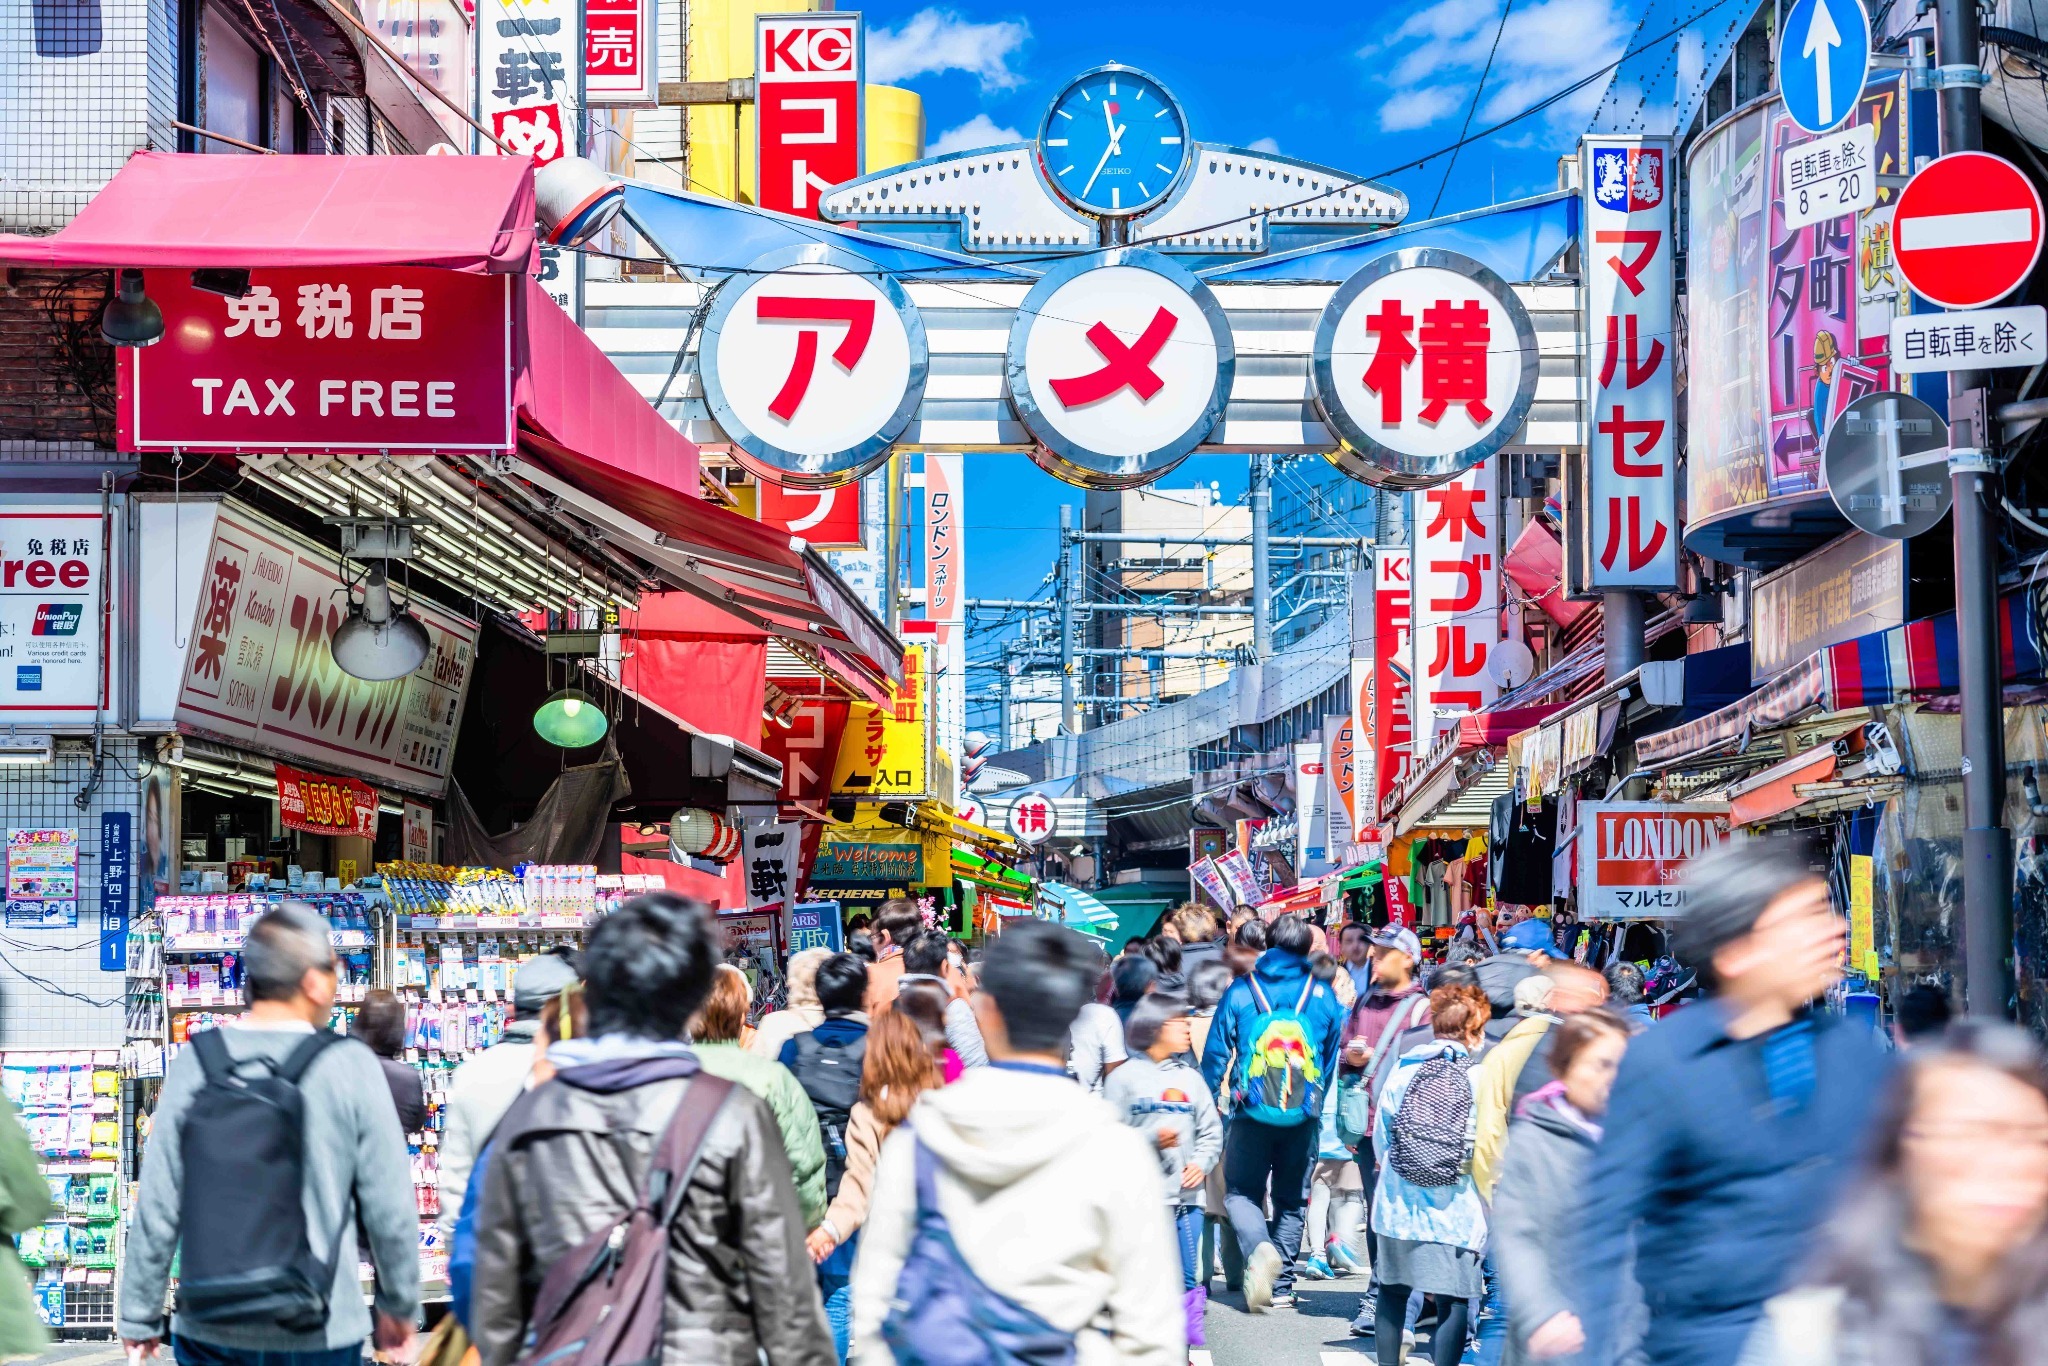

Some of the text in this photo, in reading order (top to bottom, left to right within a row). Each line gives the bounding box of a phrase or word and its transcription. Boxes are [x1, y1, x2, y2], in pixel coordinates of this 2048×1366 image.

[586, 27, 634, 68] 売
[764, 27, 852, 72] KG
[1101, 167, 1131, 175] SEIKO
[1790, 140, 1866, 185] 自転車を除く
[1799, 190, 1809, 215] 8
[1839, 176, 1860, 203] 20
[225, 282, 425, 340] 免税店
[757, 295, 1492, 425] アメ横
[1904, 321, 2034, 360] 自転車を除く
[191, 378, 456, 417] TAX FREE
[1595, 230, 1668, 573] マルセル
[27, 538, 90, 556] 免税店
[930, 492, 950, 608] ロンドン スポーツ
[0, 559, 90, 588] ree
[251, 551, 284, 585] SHISEIDO
[1384, 557, 1410, 582] K
[37, 611, 79, 623] UnionPay
[194, 555, 241, 682] 薬
[244, 590, 275, 628] Kanebo
[434, 646, 464, 688] Tax-free
[226, 678, 256, 712] SOFINA
[877, 769, 912, 787] 入口
[834, 845, 918, 863] Welcome
[1603, 818, 1721, 861] LONDON
[109, 848, 122, 931] 上野四丁目
[803, 887, 906, 900] KECHERS Kids
[1660, 868, 1692, 880] SPO
[1387, 876, 1405, 926] Tax Fre
[792, 915, 818, 927] ARIS
[110, 943, 116, 960] 1
